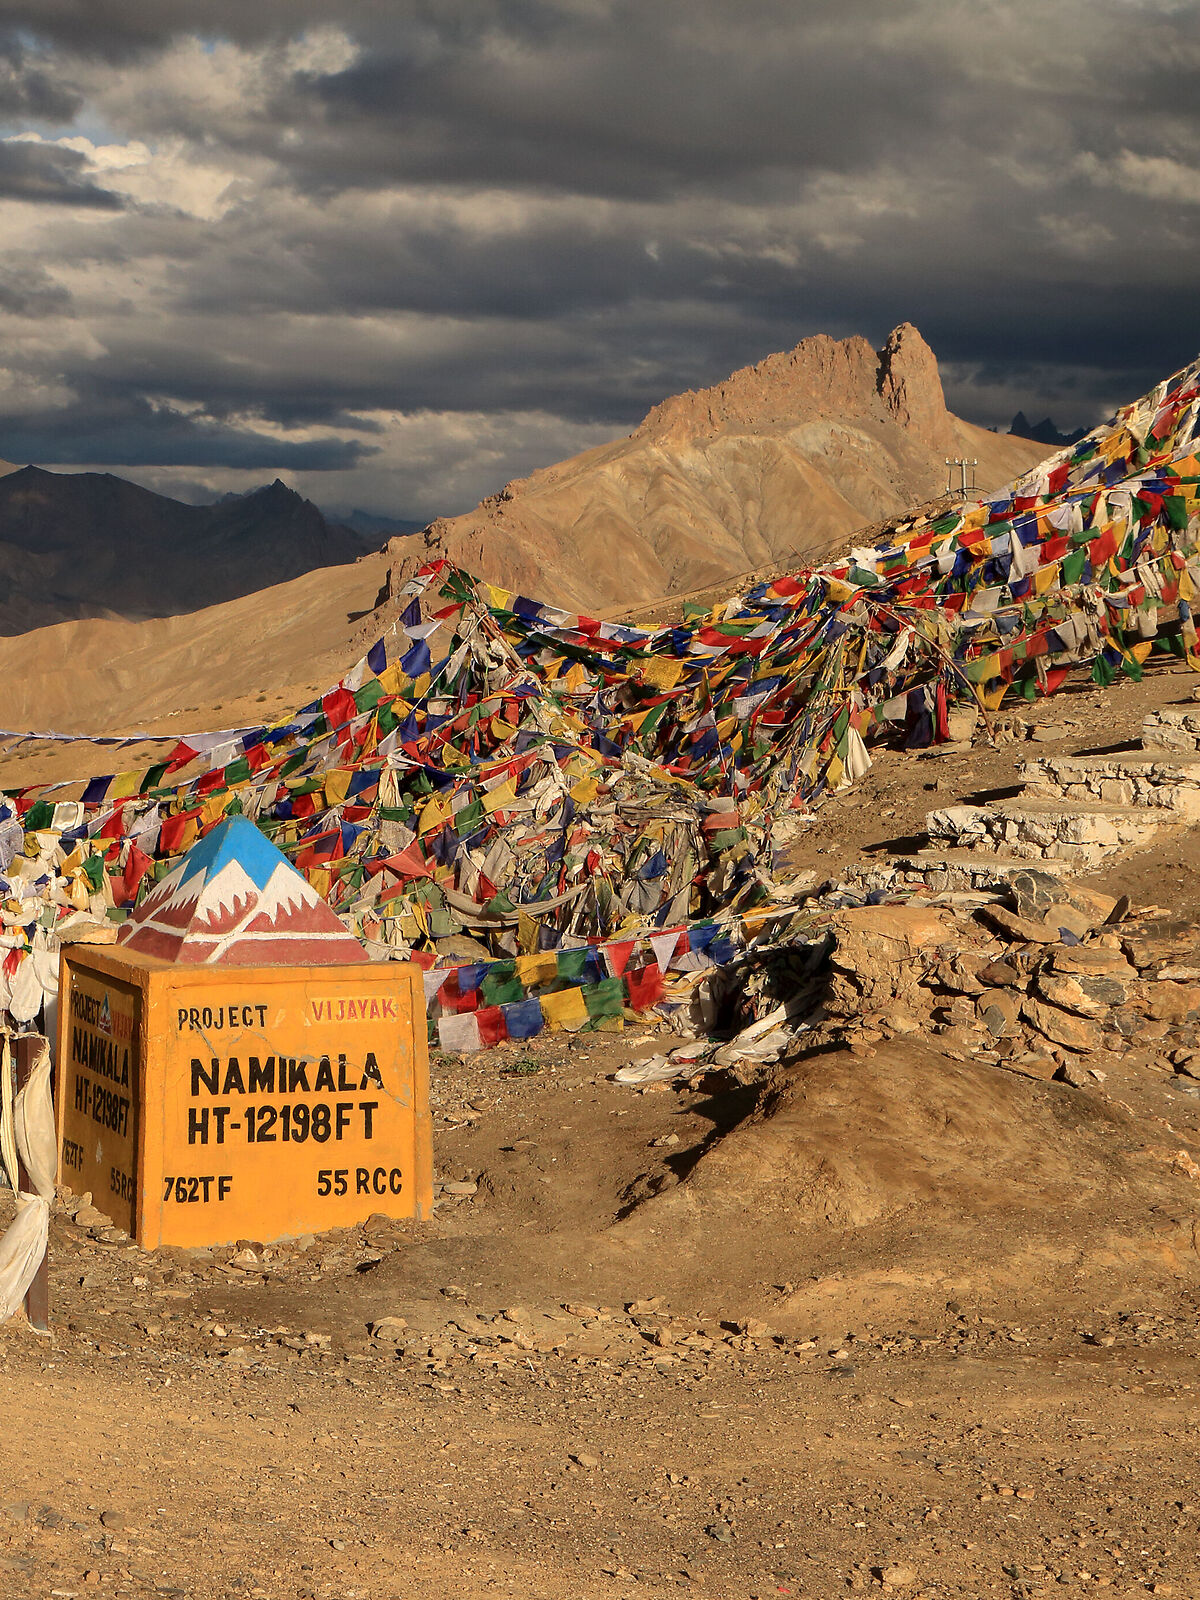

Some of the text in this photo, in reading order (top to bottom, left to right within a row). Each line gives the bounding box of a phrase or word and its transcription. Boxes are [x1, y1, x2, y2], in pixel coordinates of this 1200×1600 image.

[70, 989, 101, 1028] PROJECT
[178, 997, 397, 1031] PROJECT VIJAYAK
[72, 1026, 130, 1089] NAMIKALA
[190, 1052, 384, 1097] NAMIKALA
[188, 1101, 379, 1145] HT-12198FT
